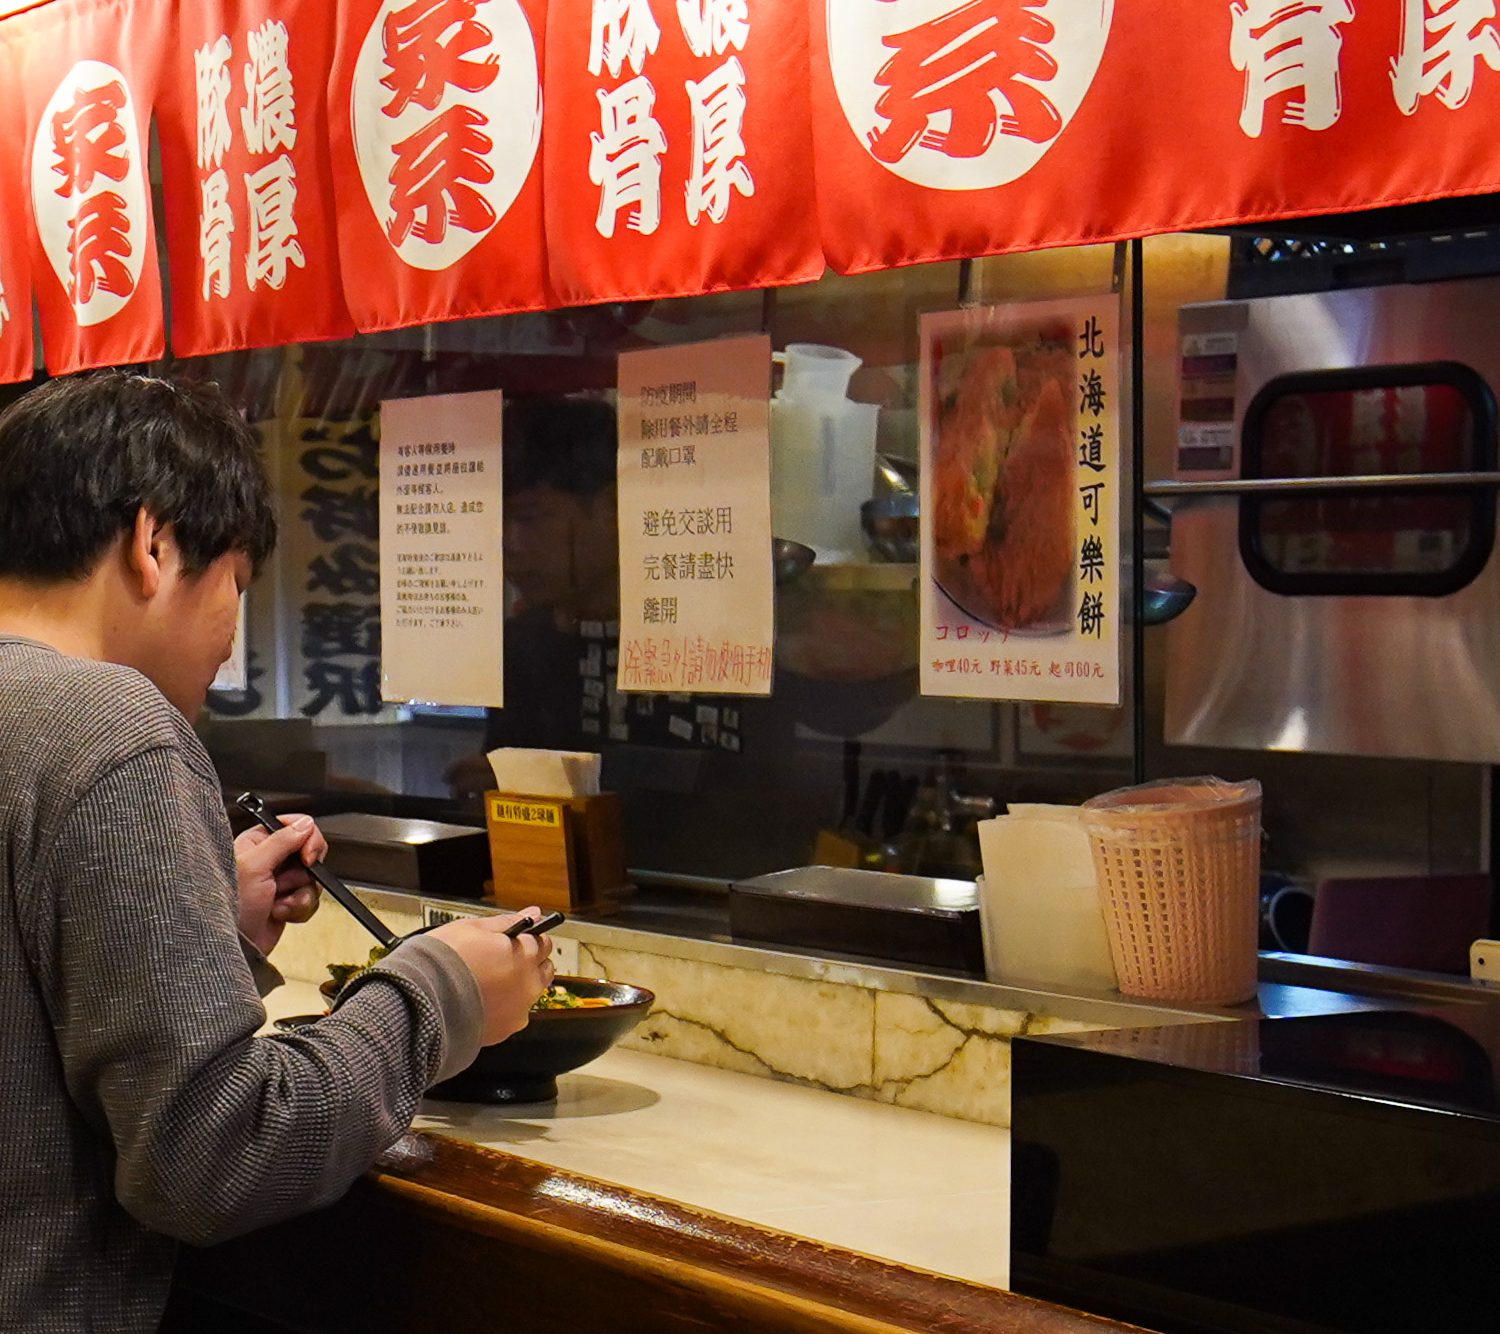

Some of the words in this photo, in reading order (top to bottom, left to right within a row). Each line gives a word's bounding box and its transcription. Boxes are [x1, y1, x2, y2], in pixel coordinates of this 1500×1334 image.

[194, 33, 233, 301] 豚骨
[242, 19, 305, 290] 濃厚
[50, 79, 134, 305] 家系
[640, 380, 696, 406] 防疫期間
[641, 445, 696, 468] 配戴口罩
[1077, 316, 1106, 639] 北海道可樂餅
[643, 507, 732, 536] 避免交談用
[644, 551, 733, 581] 完餐請盡快
[644, 597, 677, 624] 離開
[1049, 660, 1104, 678] 起司60元
